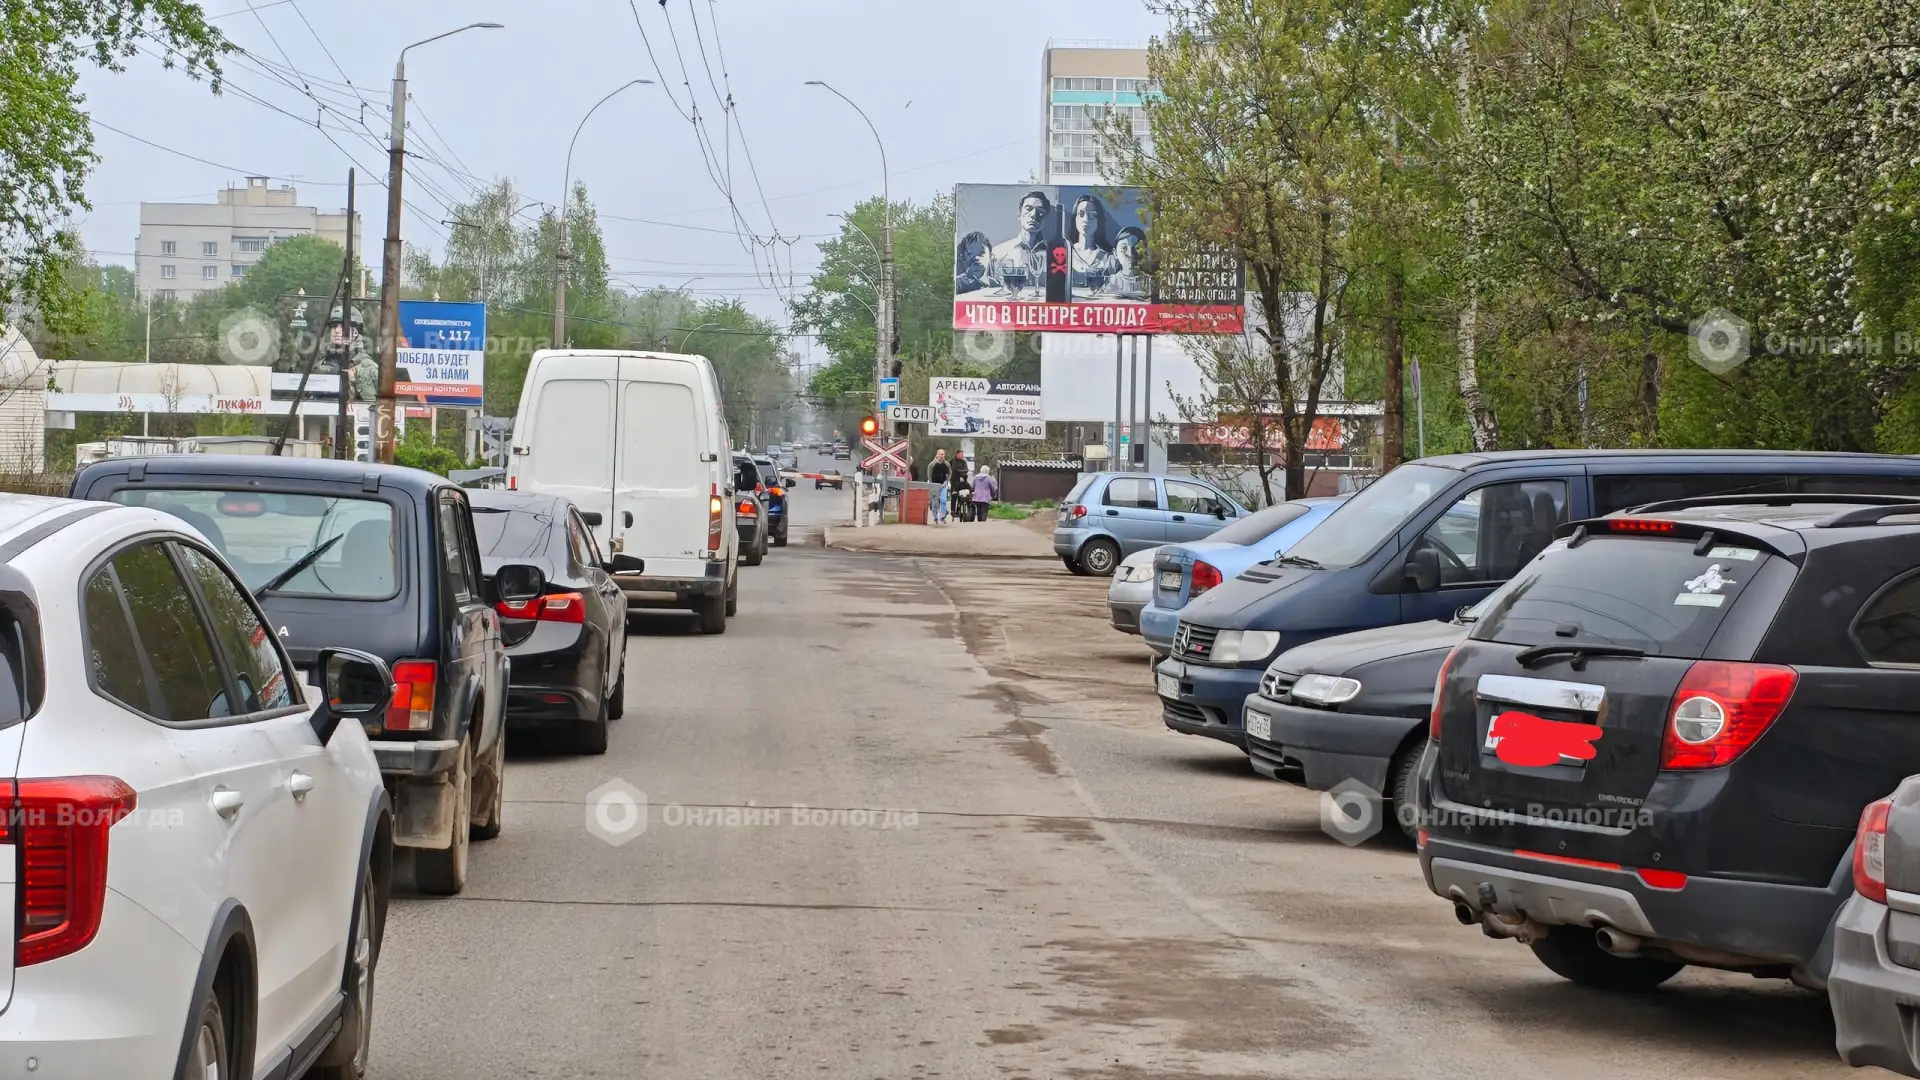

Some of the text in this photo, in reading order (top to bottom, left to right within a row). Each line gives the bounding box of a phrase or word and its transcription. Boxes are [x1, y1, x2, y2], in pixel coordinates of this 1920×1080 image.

[1160, 254, 1238, 269] ШИЛИСЬ
[965, 304, 997, 325] ЧТО
[1001, 305, 1011, 325] В
[1016, 305, 1079, 328] ЦЕНТРЕ
[1083, 306, 1148, 327] СТОЛА?
[448, 329, 471, 341] 117
[396, 351, 470, 367] ПОБЕДА БУДЕТ
[425, 367, 469, 380] ЗА НАМИ
[935, 380, 986, 392] АРЕНДА
[217, 398, 262, 410] ЛУКОЙЛ
[1003, 398, 1014, 406] 40
[893, 407, 930, 420] СТОП
[992, 425, 1042, 436] 50-30-40
